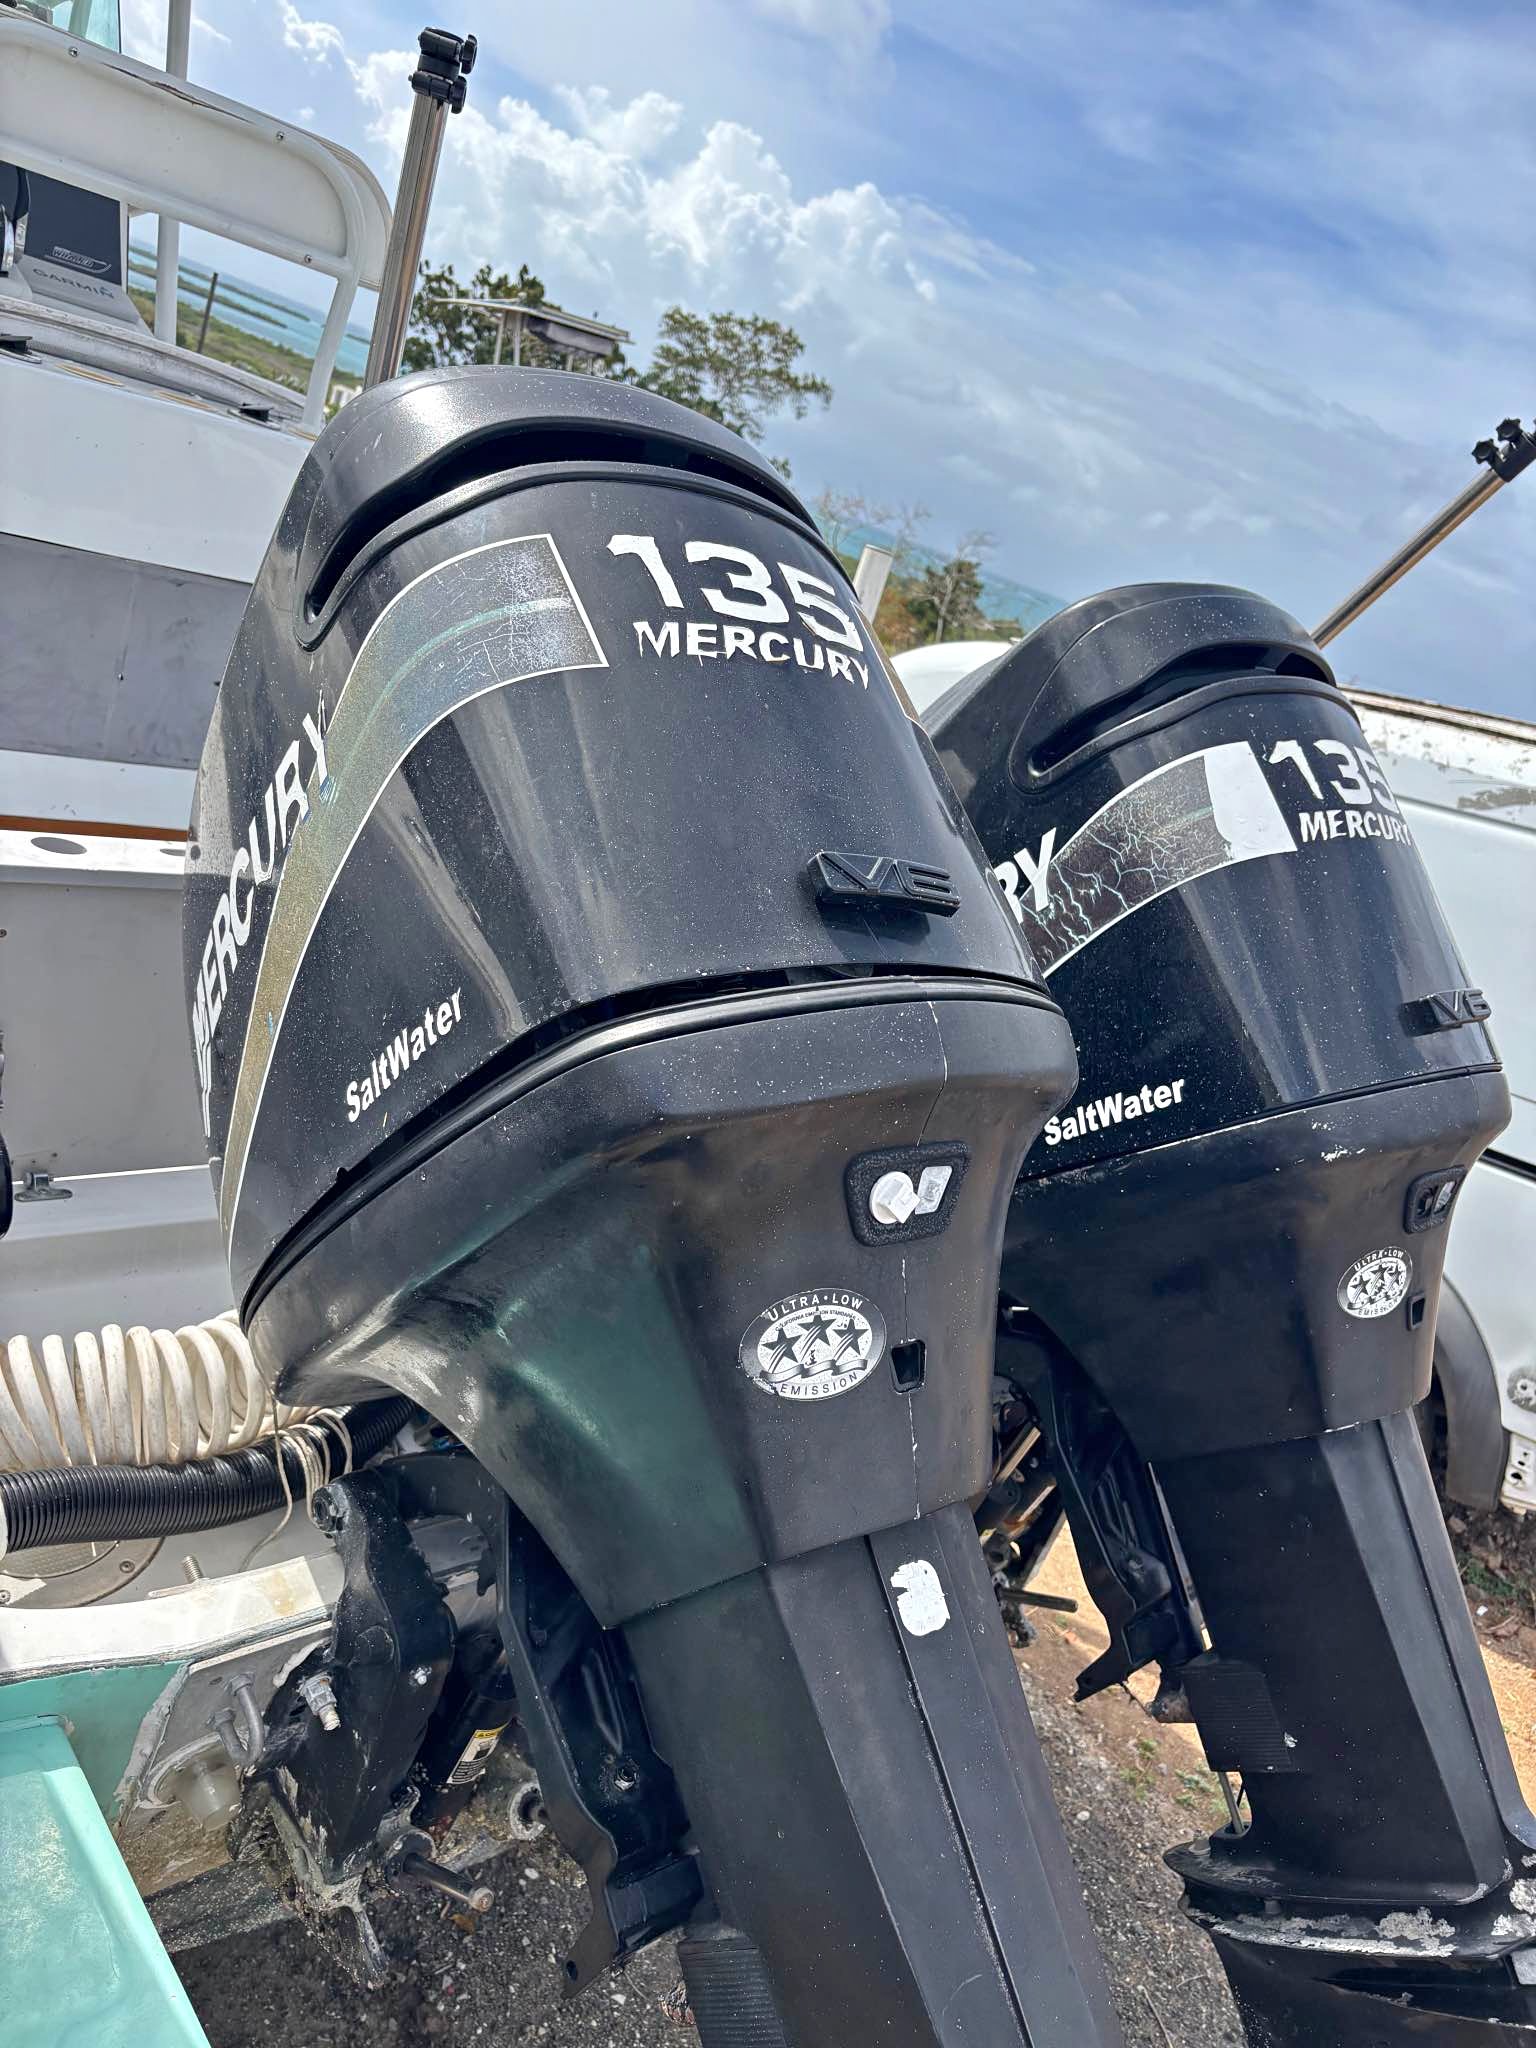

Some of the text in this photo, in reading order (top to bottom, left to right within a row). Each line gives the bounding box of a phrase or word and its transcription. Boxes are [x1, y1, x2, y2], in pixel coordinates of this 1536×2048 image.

[606, 534, 864, 653] 135
[633, 620, 870, 690] MERCURY
[1268, 739, 1400, 814] 135
[192, 690, 332, 1137] MERCURY
[346, 988, 464, 1123] SaltWater
[1043, 1079, 1185, 1146] SaltWater
[780, 1372, 858, 1396] EMISSION
